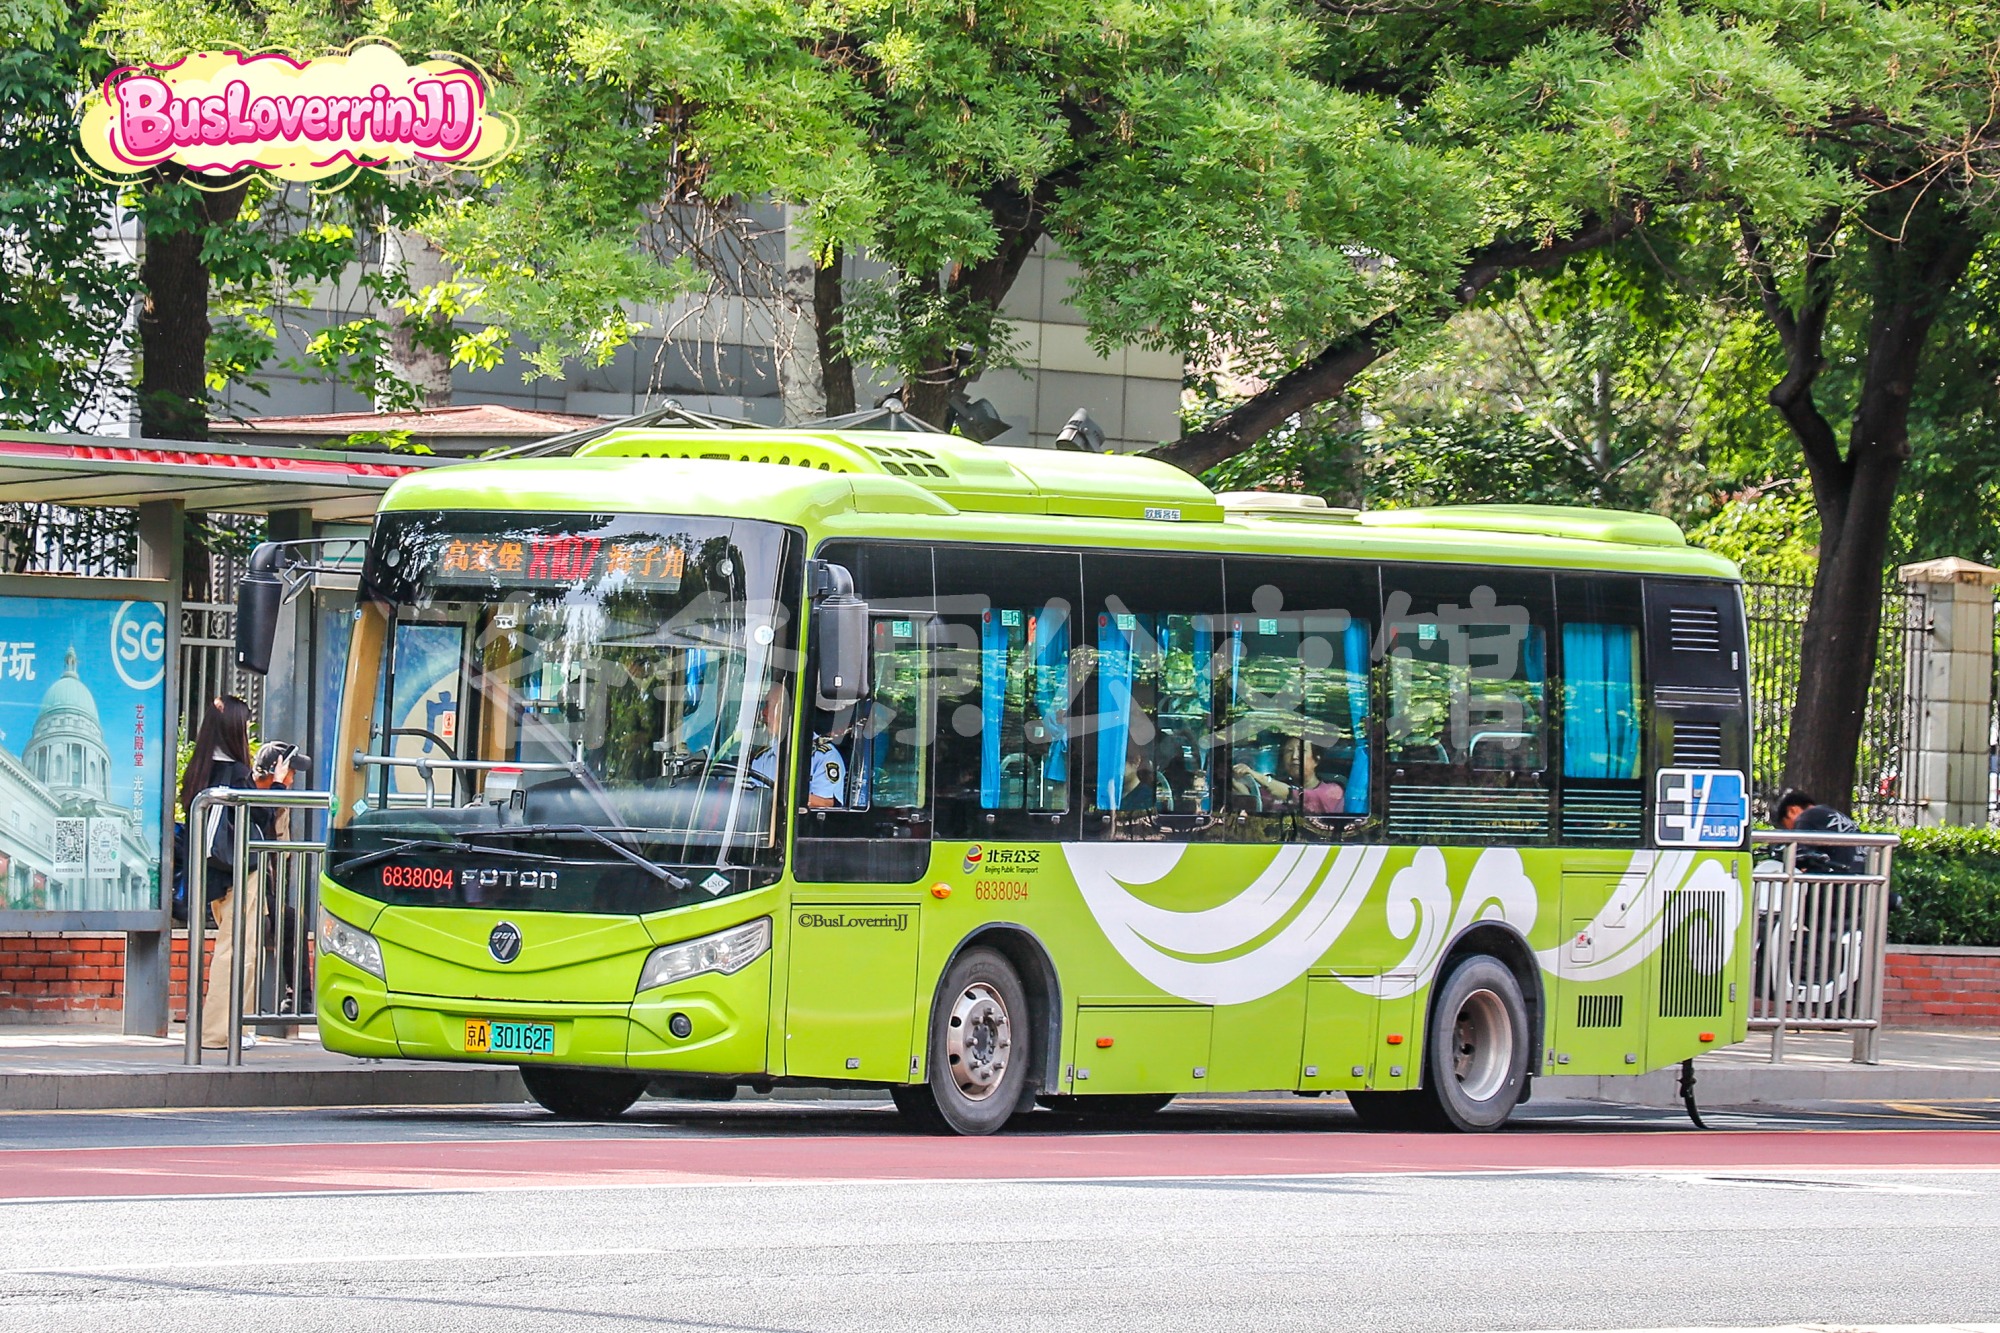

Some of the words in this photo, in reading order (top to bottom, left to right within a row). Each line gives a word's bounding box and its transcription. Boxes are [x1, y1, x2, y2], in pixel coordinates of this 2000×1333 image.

[442, 539, 524, 573] 高家堡
[528, 534, 602, 580] X107
[119, 620, 165, 662] SG
[133, 704, 145, 767] 艺术殿堂
[1659, 772, 1713, 842] EV
[1702, 825, 1739, 838] PLUG-IN
[986, 849, 1041, 863] 北京公交
[382, 865, 454, 890] 6838094
[461, 868, 558, 890] FOTON
[985, 866, 1000, 875] Beijing
[1001, 866, 1015, 874] Public
[1016, 866, 1039, 875] Transport
[975, 881, 1029, 901] 6838094
